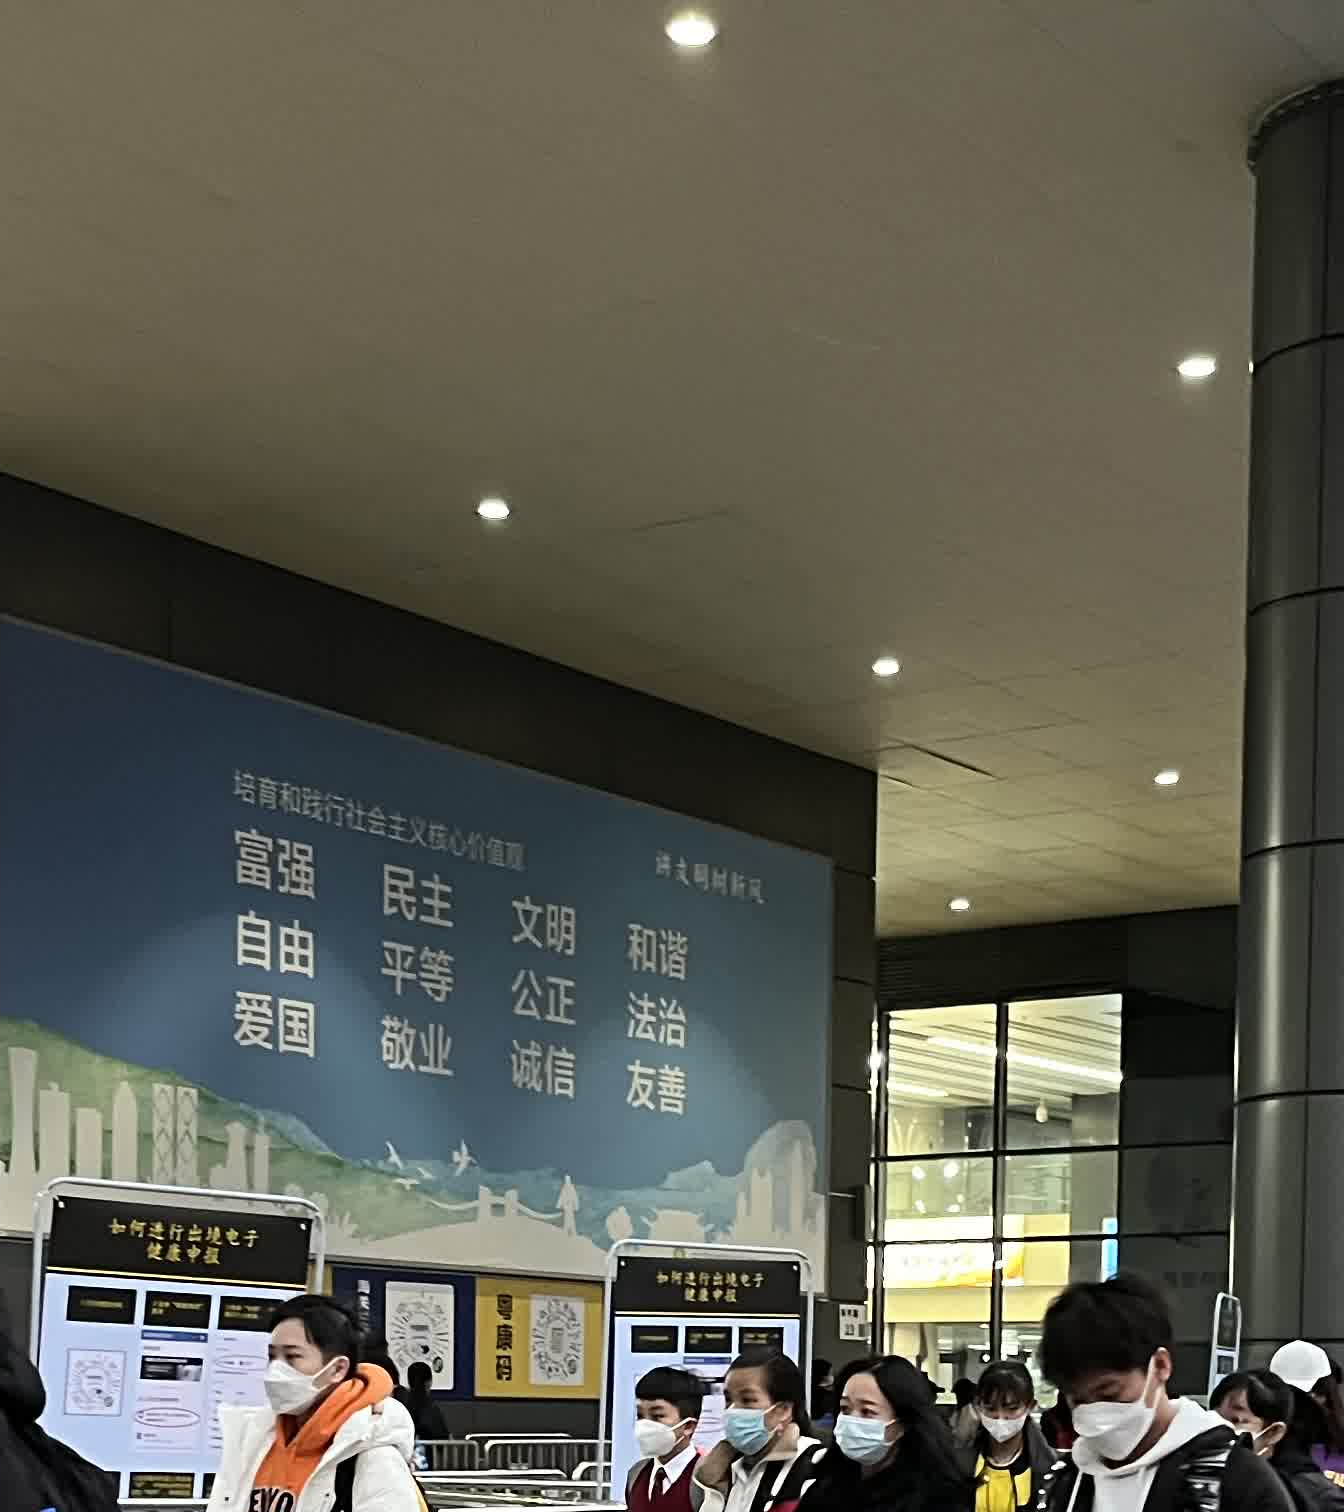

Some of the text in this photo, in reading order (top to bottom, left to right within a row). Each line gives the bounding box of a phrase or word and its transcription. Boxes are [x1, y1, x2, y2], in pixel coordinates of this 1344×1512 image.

[232, 768, 526, 872] 培育和践行社会主义核心价值观
[233, 828, 688, 981] 富强 民主 文明 和谐
[235, 911, 687, 1049] 自由 平等 公正 法治
[233, 990, 687, 1117] 爱国 敬业 诚信 友善
